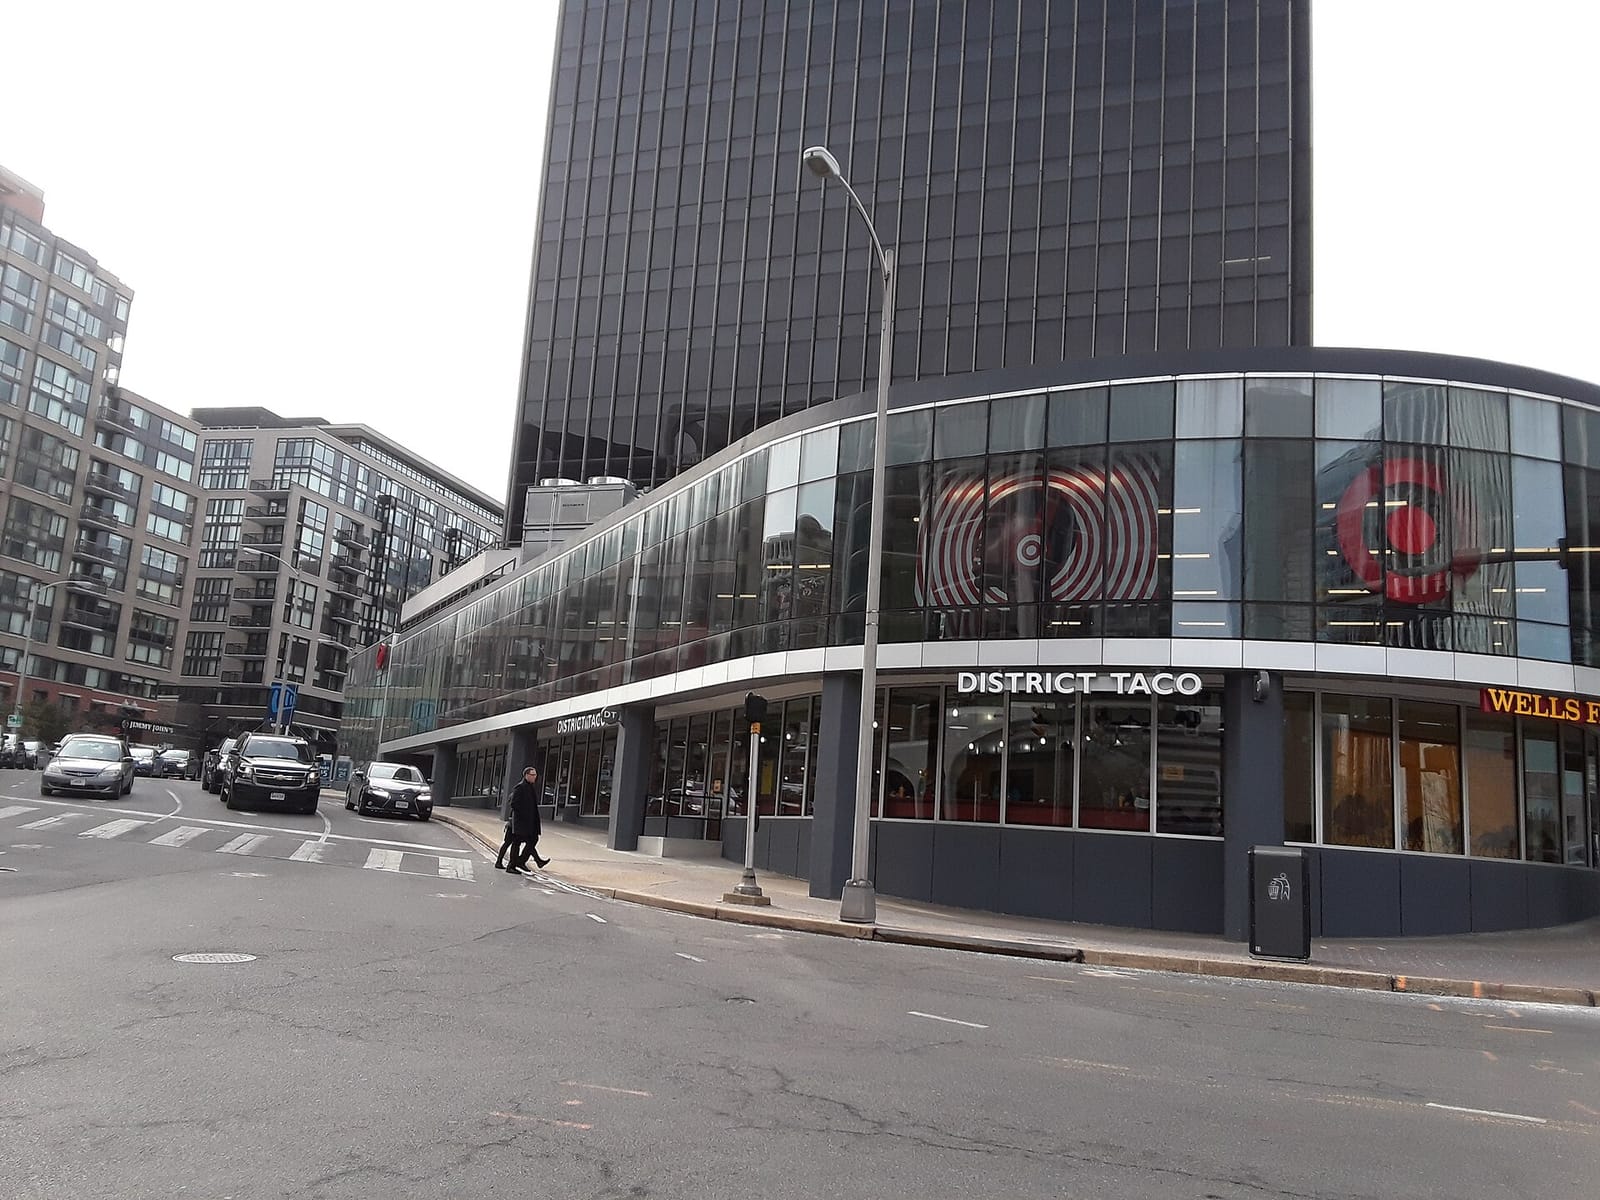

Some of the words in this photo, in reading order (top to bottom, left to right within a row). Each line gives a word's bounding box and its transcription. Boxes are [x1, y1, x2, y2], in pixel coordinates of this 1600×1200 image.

[957, 672, 1097, 694] DISTRICT
[1110, 672, 1203, 695] TACO
[604, 710, 617, 719] DT
[1487, 688, 1581, 721] WELLS
[557, 716, 586, 734] DISTRICT
